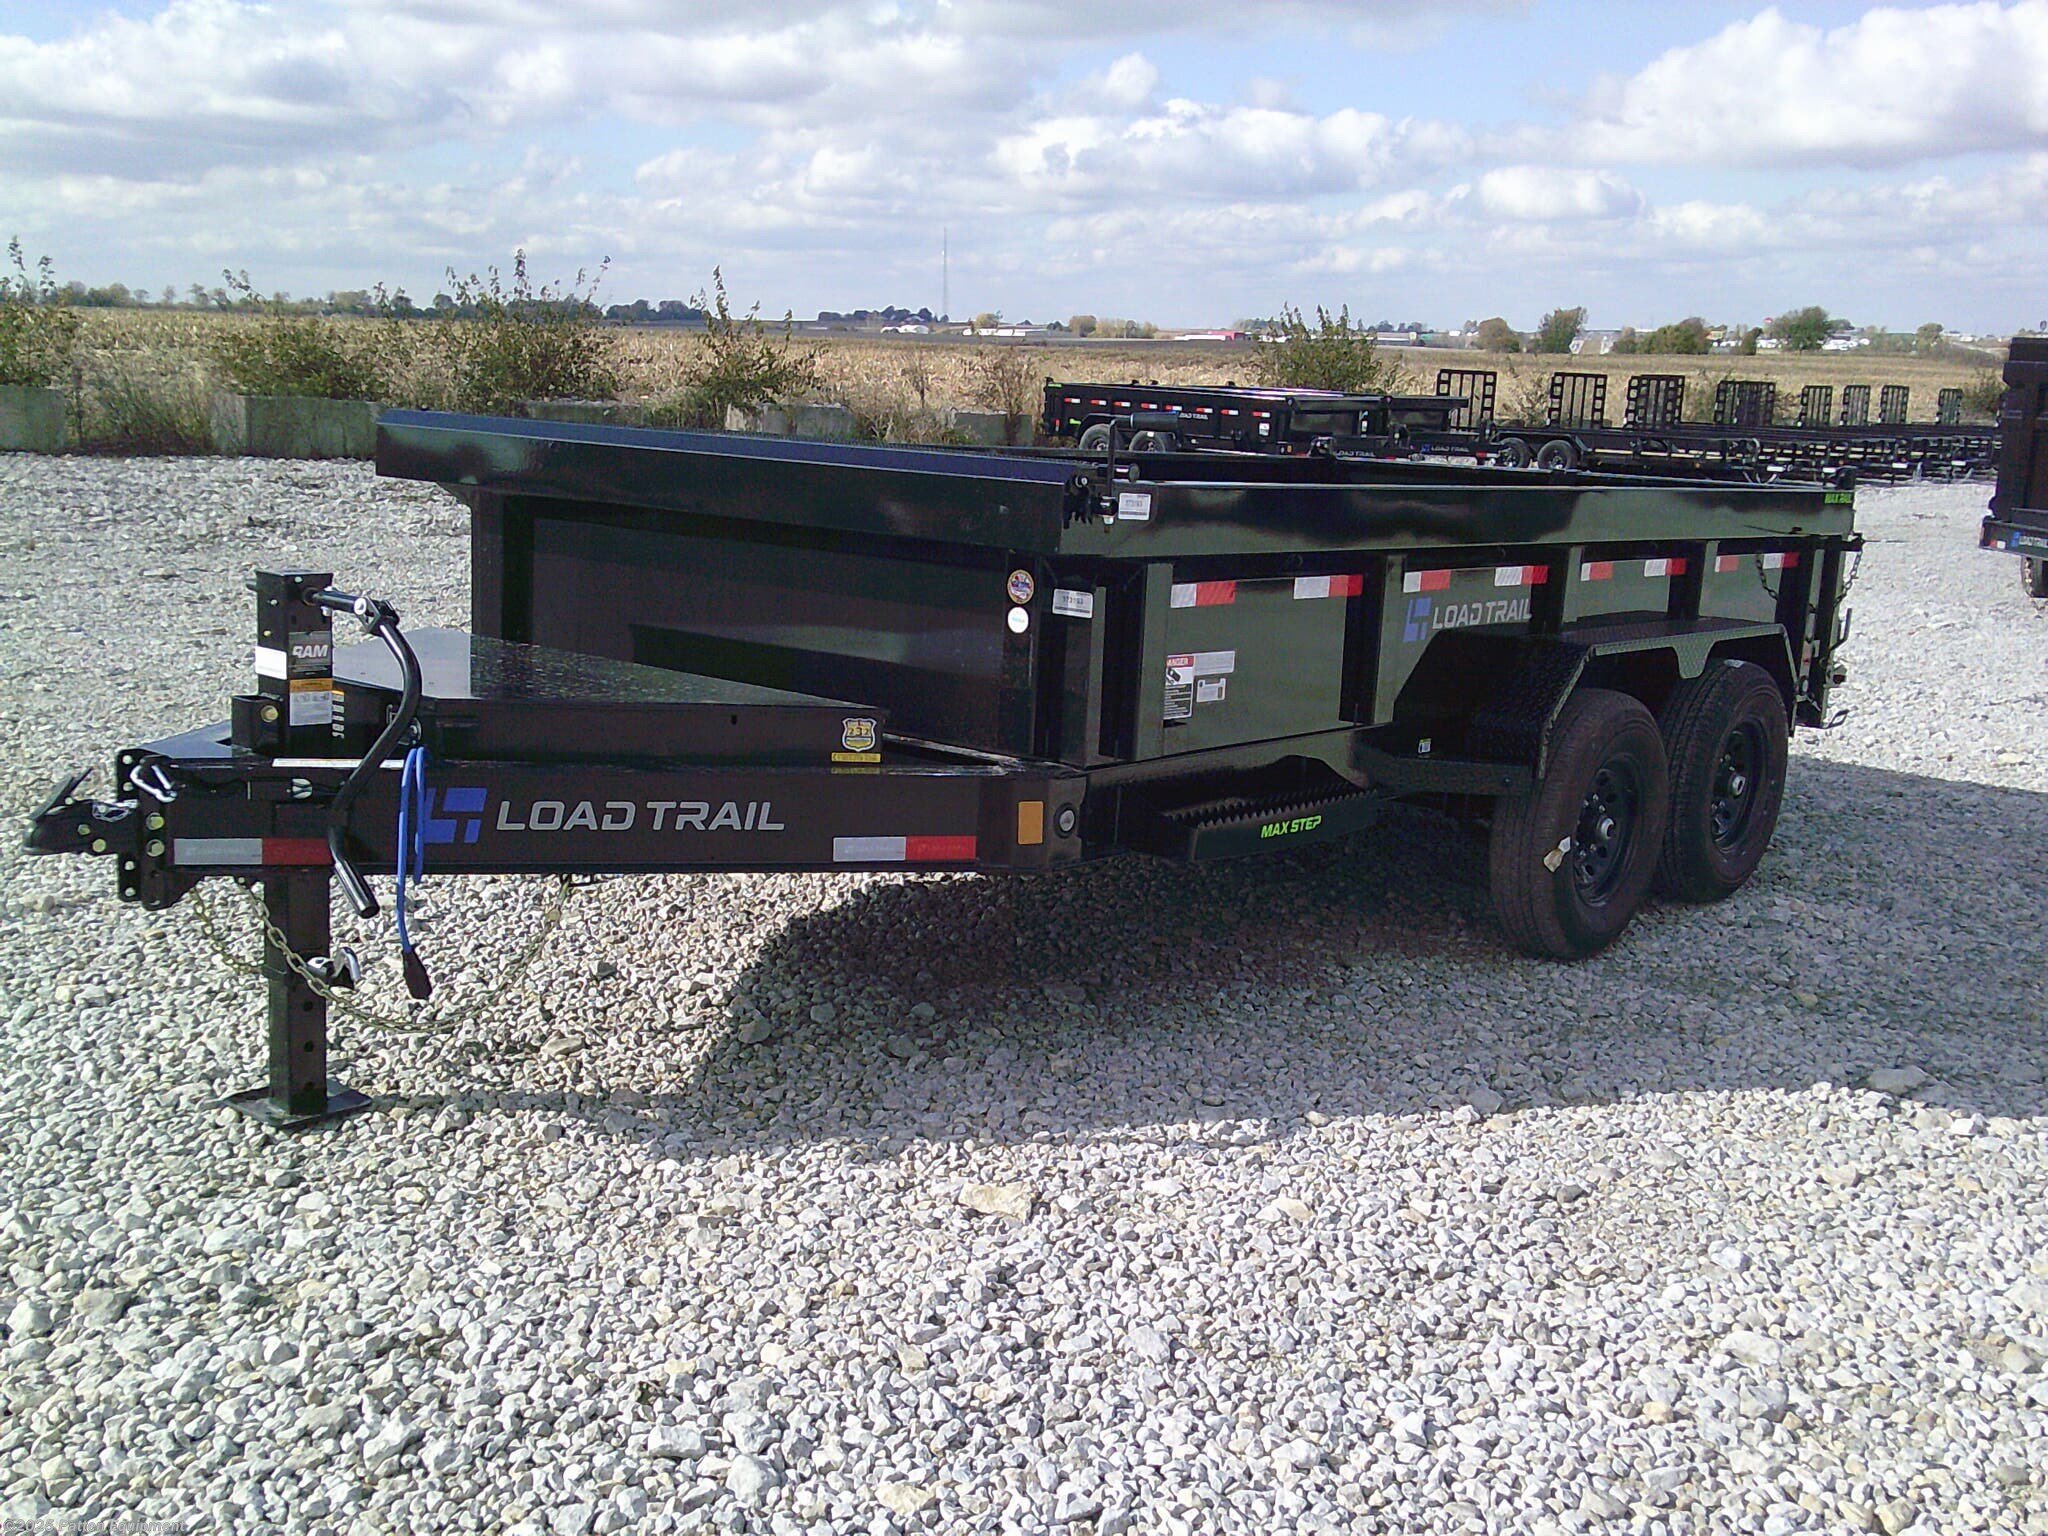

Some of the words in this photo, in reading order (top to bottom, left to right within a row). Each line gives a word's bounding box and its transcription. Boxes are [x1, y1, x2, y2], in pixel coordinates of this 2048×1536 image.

[1432, 603, 1483, 629] LOAD
[1486, 598, 1532, 623] TRAIL
[292, 644, 328, 658] RAM
[1167, 657, 1188, 667] ANGER
[496, 801, 637, 831] LOAD
[646, 801, 785, 831] TRAIL
[1261, 820, 1290, 838] MAX
[1290, 815, 1322, 833] STEP
